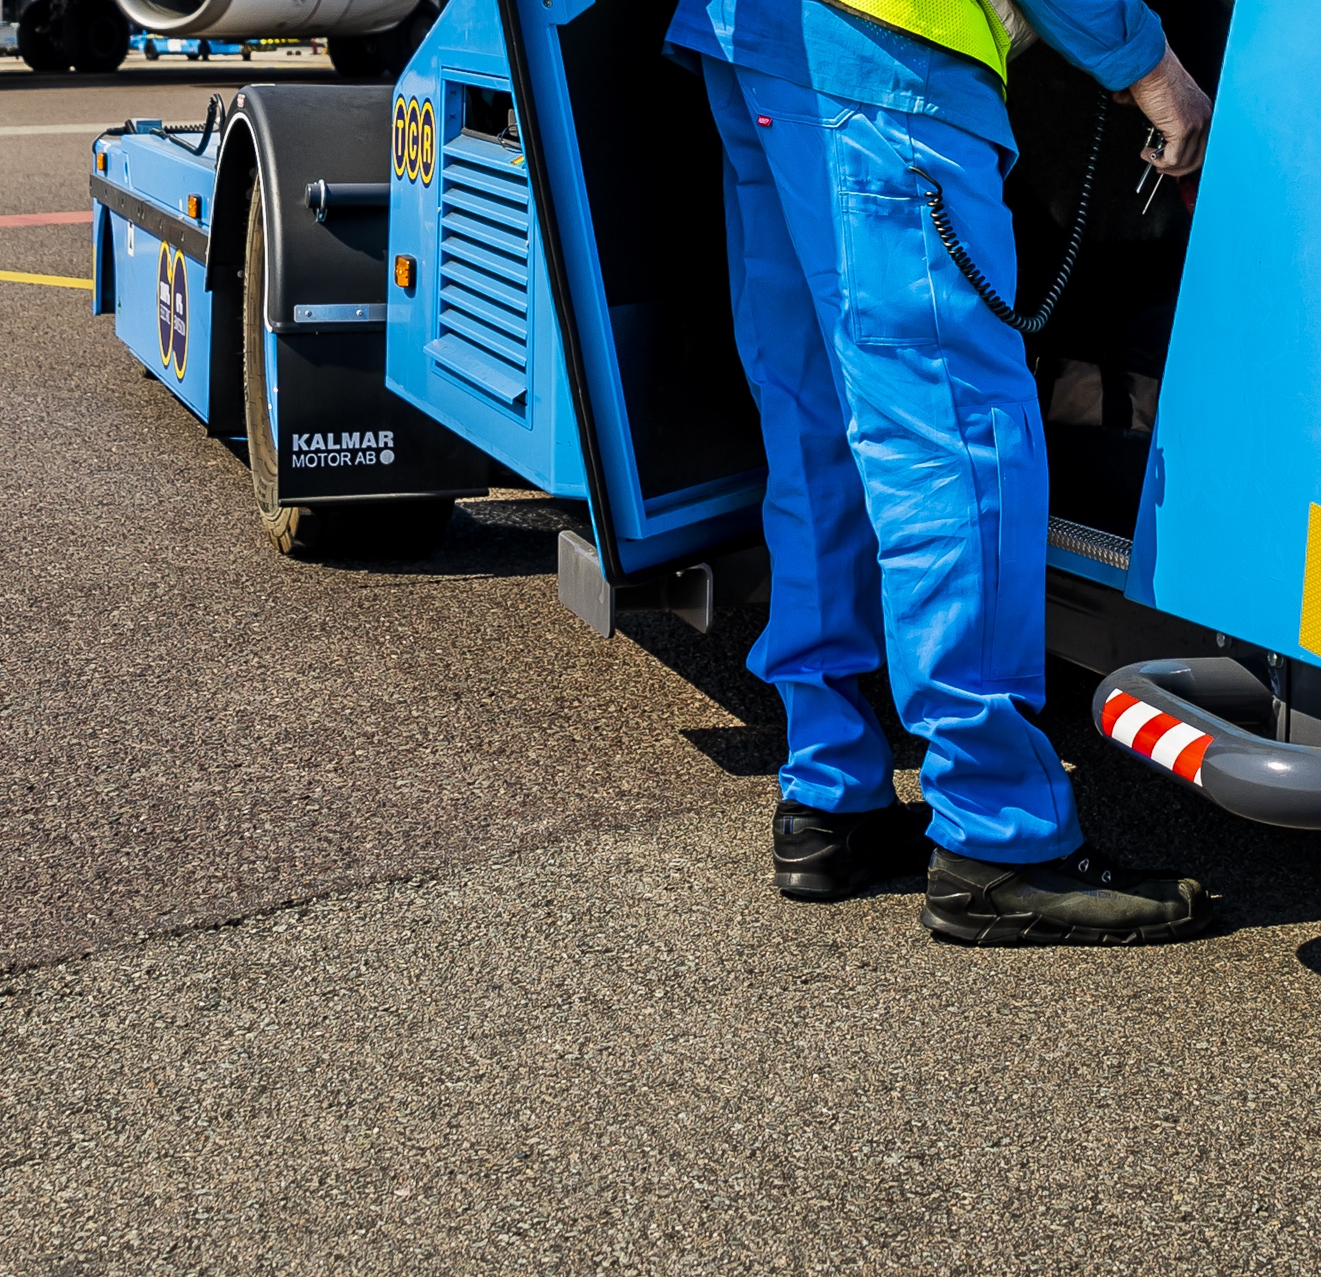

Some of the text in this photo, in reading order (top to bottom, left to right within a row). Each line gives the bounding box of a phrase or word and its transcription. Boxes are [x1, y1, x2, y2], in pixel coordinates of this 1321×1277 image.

[292, 430, 395, 452] KALMAR
[292, 451, 376, 468] MOTOR AB
